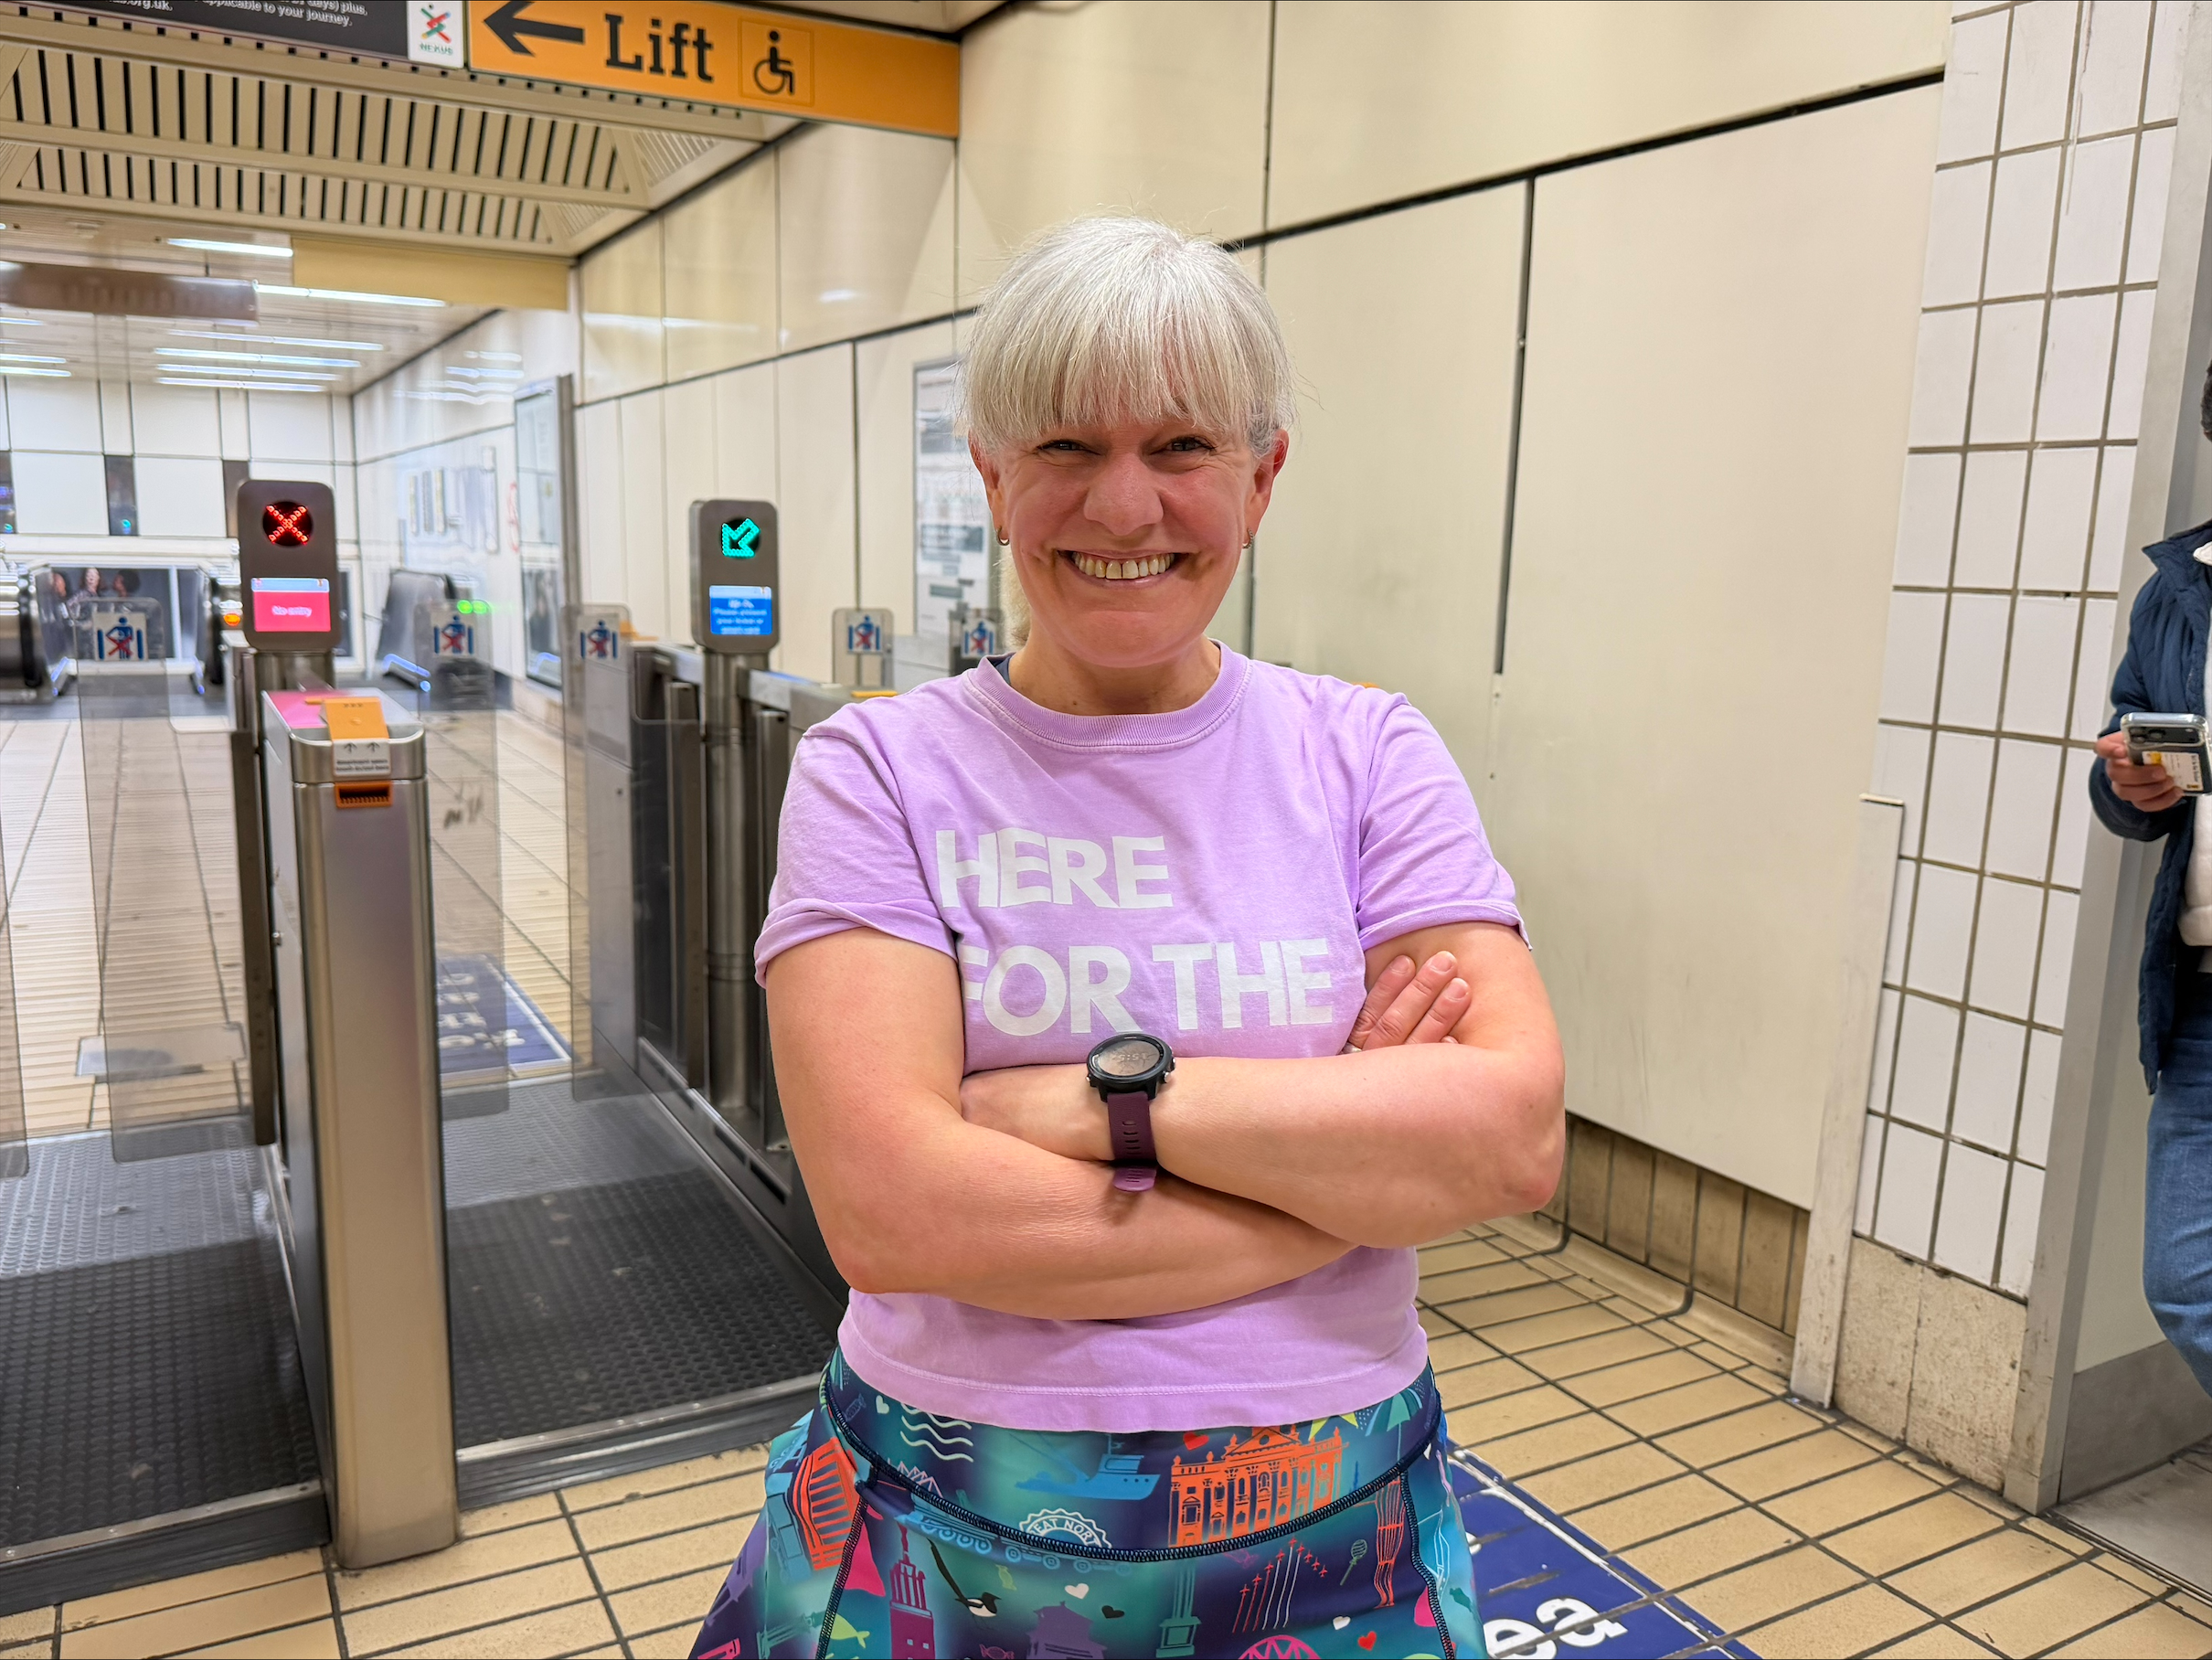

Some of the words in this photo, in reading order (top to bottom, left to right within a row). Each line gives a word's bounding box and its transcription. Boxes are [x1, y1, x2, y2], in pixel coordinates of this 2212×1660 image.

[263, 3, 275, 14] to
[277, 5, 304, 17] your
[420, 43, 453, 56] NEXUS
[605, 13, 714, 83] Lift
[936, 827, 1173, 909] HERE
[1153, 938, 1333, 1030] THE
[1029, 1518, 1058, 1536] EAT
[1064, 1519, 1099, 1546] NORT
[1483, 1598, 1628, 1659] ea
